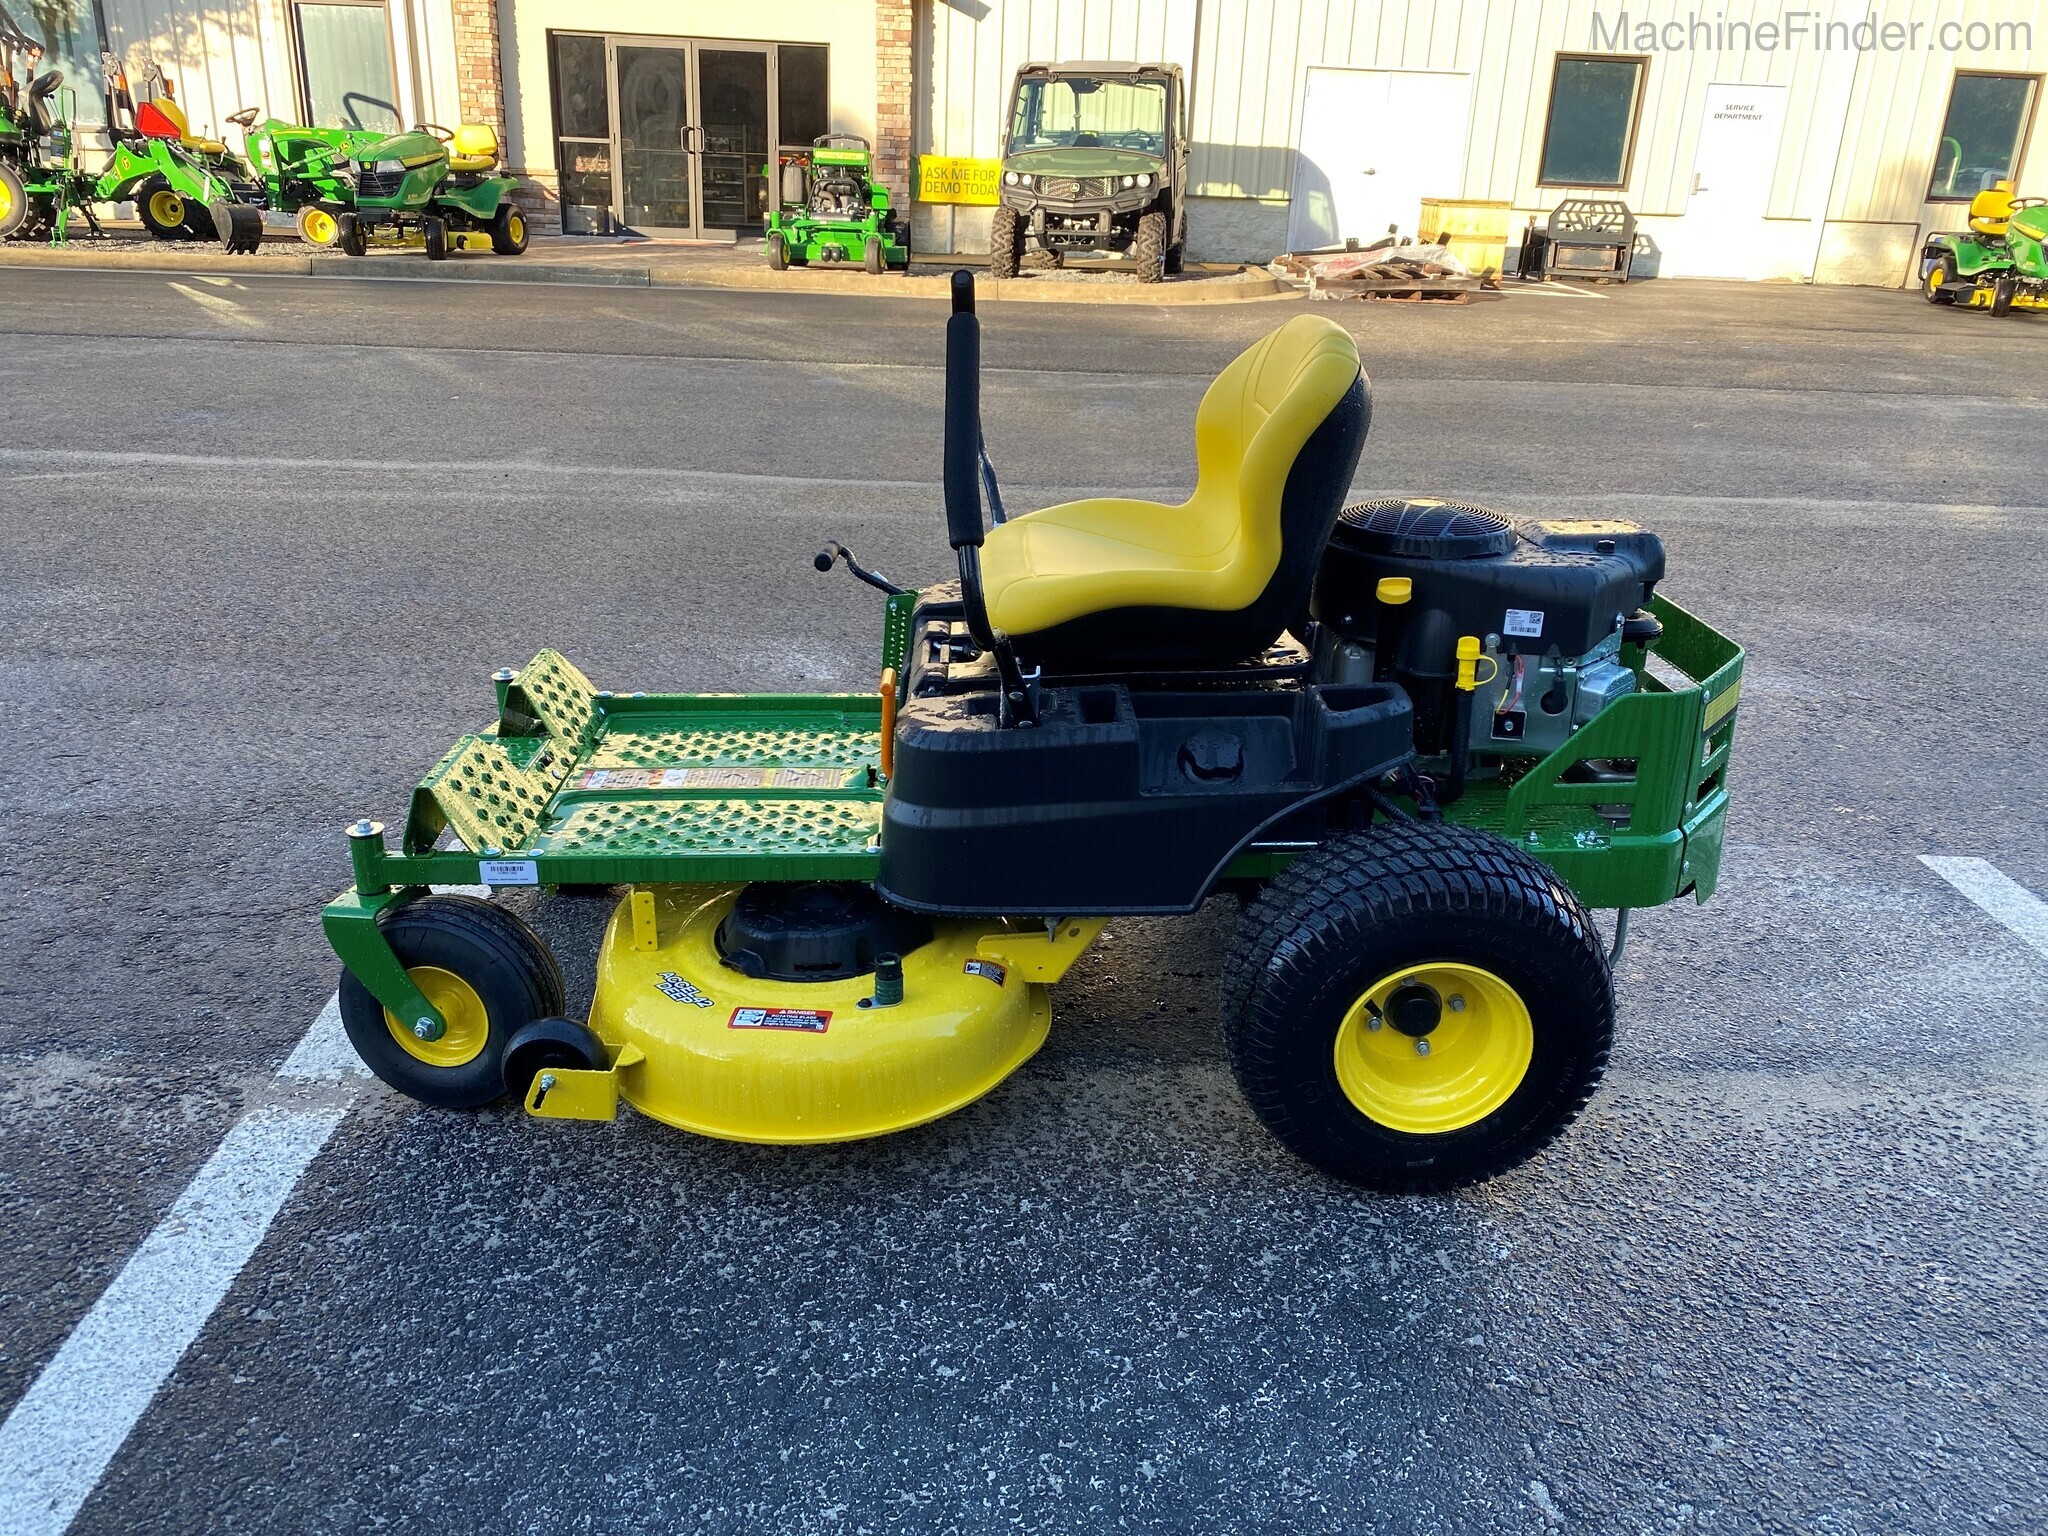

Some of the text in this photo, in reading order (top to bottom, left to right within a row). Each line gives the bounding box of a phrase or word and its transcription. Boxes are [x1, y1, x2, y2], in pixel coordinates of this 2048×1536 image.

[925, 167, 996, 182] ASK ME FOR
[925, 181, 1000, 196] DEMO TODAY
[654, 982, 694, 1003] DEEP
[656, 972, 714, 1008] ACCEL 42
